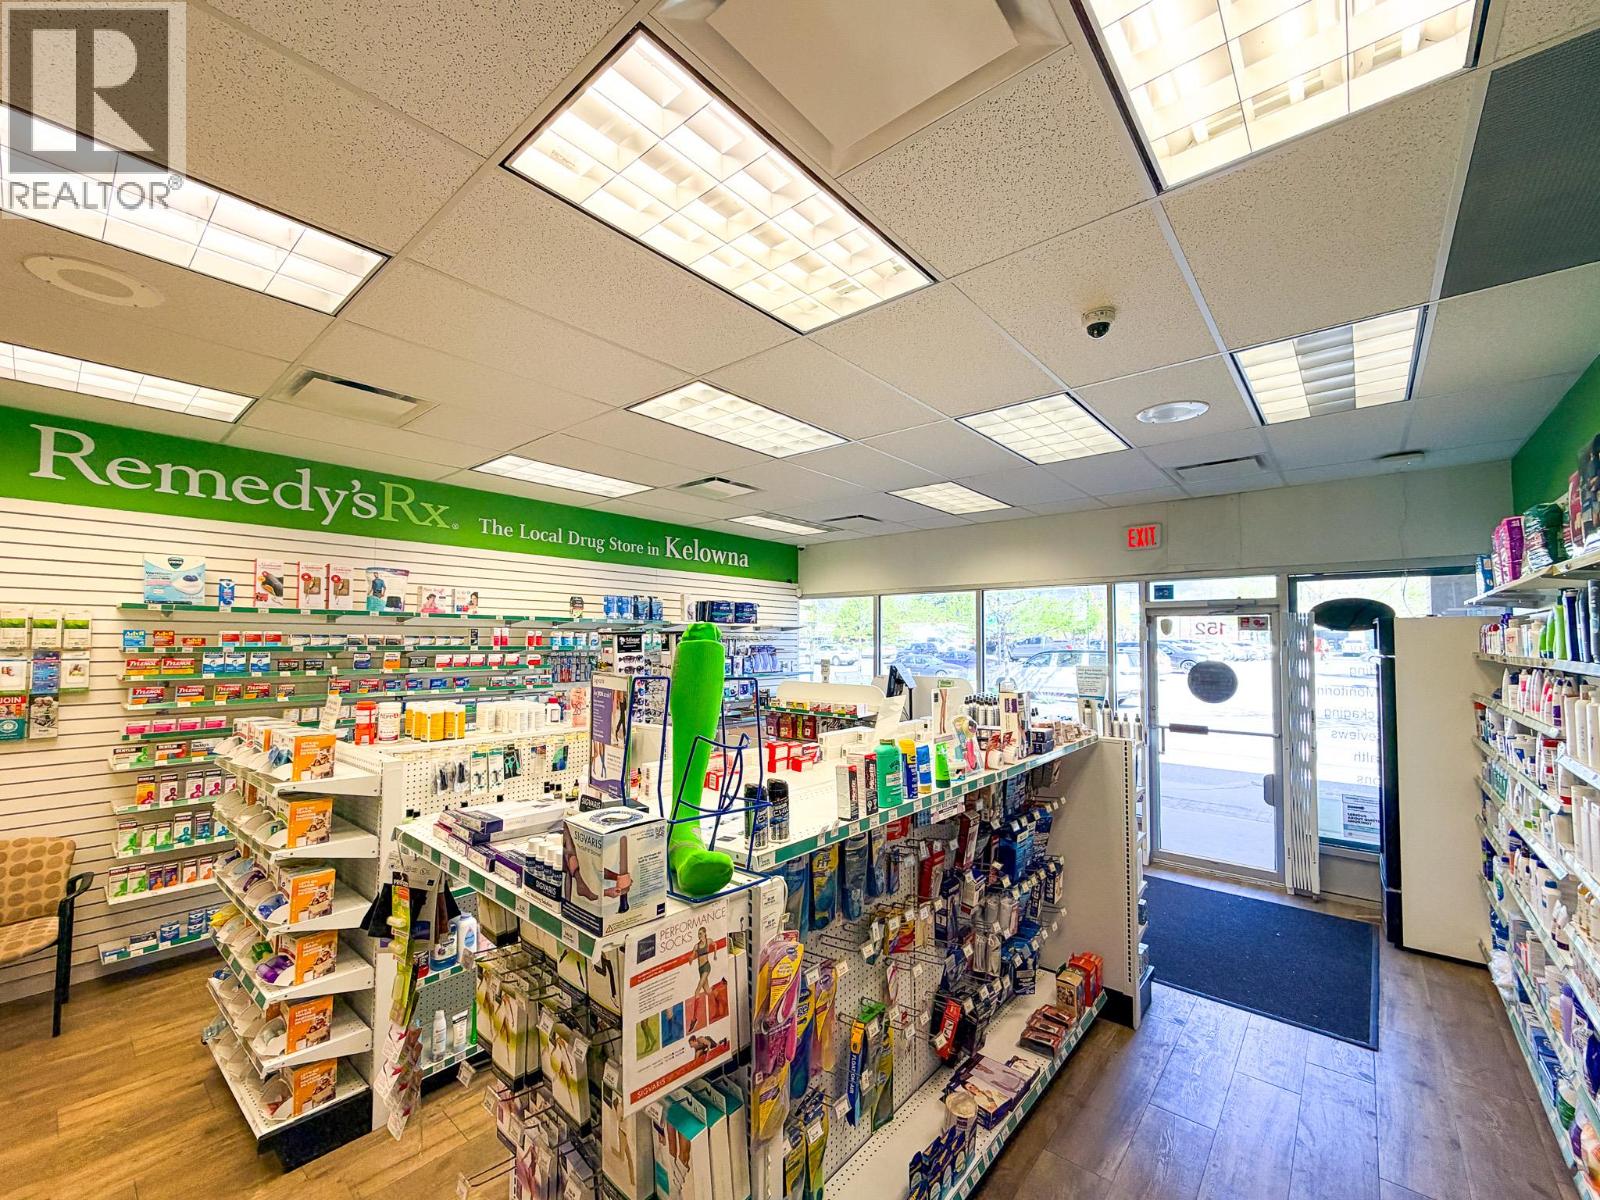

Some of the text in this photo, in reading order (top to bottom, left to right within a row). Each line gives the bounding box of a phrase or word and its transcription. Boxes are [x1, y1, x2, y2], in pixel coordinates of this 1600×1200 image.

[479, 518, 750, 568] The Local Drug Store in Kelowna
[1128, 527, 1156, 548] EXIT
[581, 797, 601, 808] SIGVARIS
[574, 830, 602, 849] SIGVARIS
[816, 860, 830, 868] FIT
[535, 880, 557, 896] SIGVARIS
[659, 906, 727, 941] PERFORMANCE
[660, 931, 693, 954] SOCKS
[637, 1079, 666, 1099] SIGVARIS
